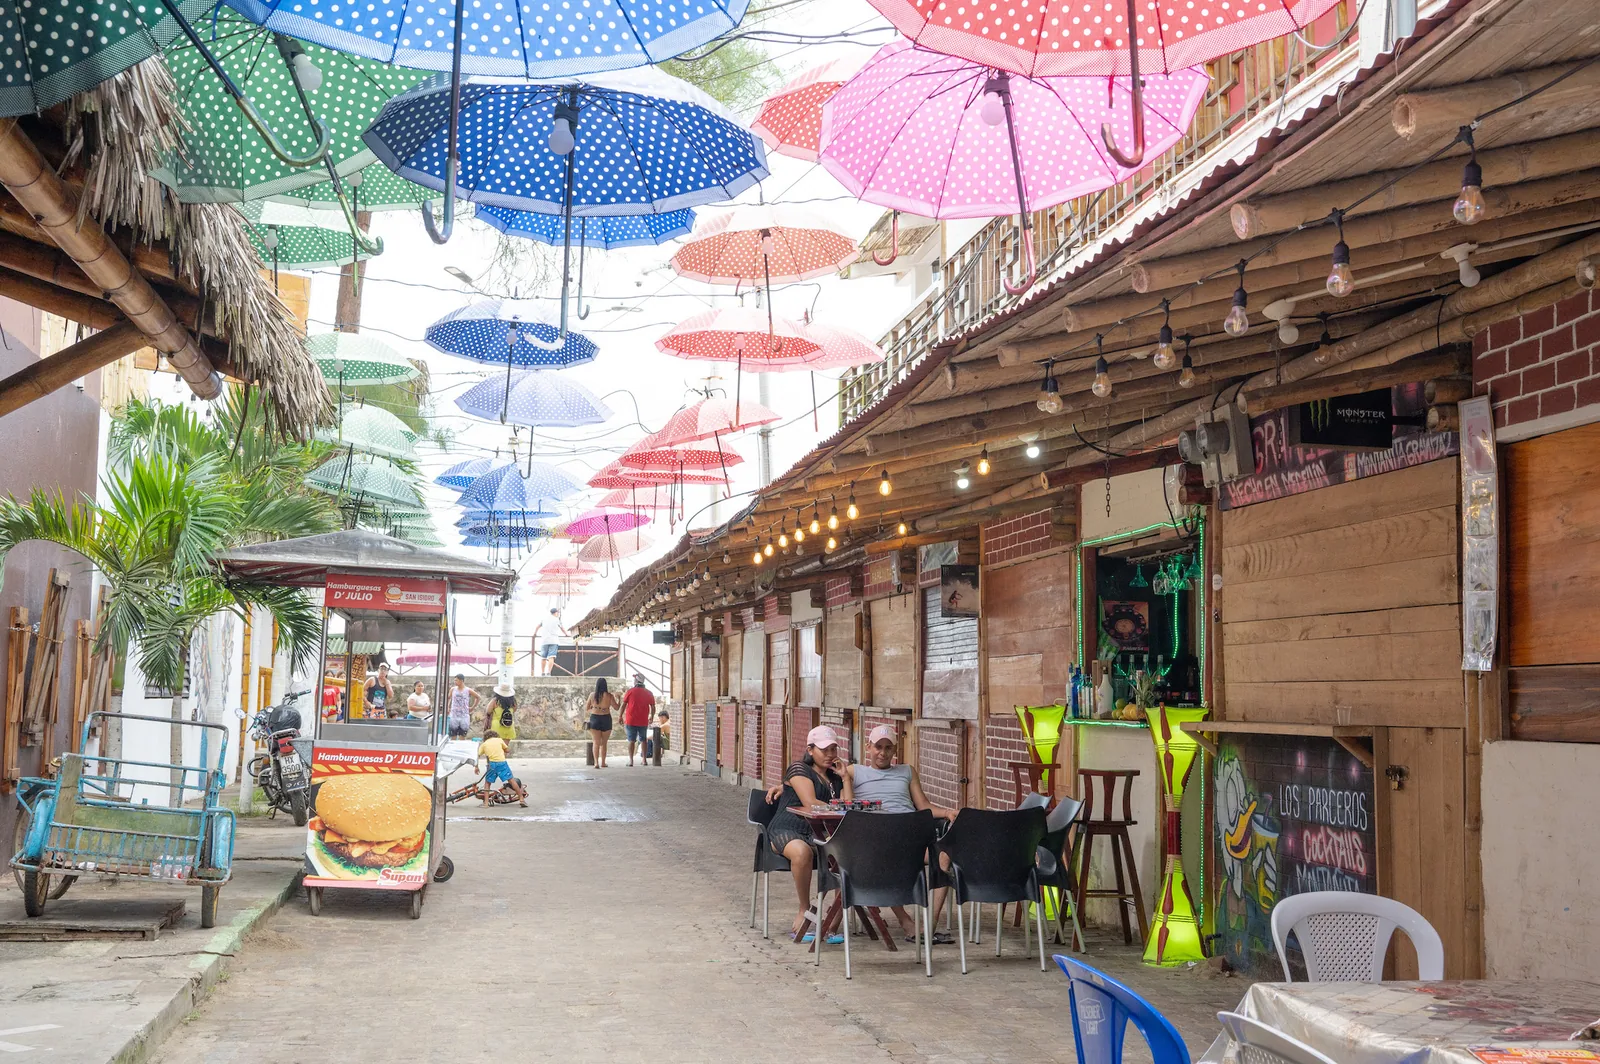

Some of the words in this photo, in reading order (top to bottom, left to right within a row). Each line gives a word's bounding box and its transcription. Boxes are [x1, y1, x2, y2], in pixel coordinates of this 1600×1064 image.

[1336, 407, 1386, 419] MONSTER
[327, 582, 381, 591] Hamburguesas
[345, 592, 373, 601] JULIO
[318, 752, 384, 764] Hamburguesas
[398, 754, 431, 766] JULIO
[1279, 784, 1300, 818] LOS
[1308, 786, 1368, 831] PARCEROS
